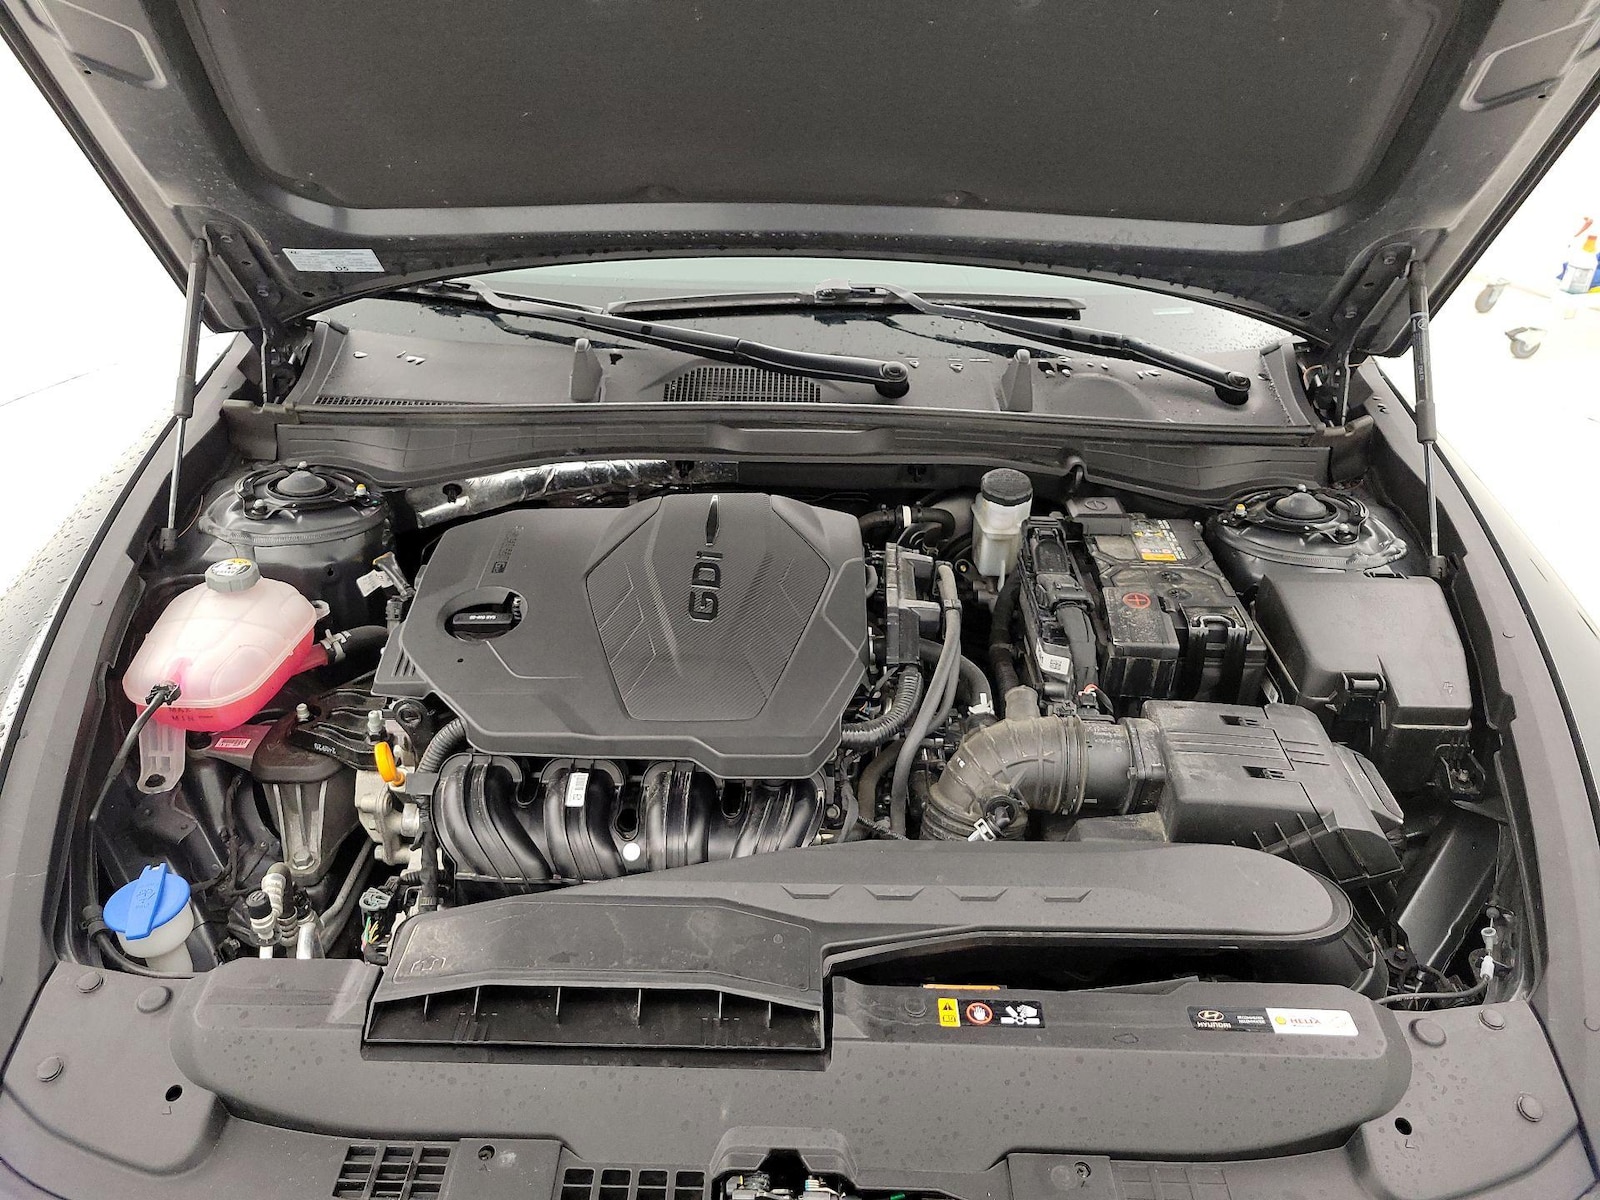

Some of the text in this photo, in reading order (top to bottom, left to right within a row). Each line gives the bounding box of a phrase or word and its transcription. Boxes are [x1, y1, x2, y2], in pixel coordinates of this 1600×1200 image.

[689, 550, 723, 622] GDi
[1197, 1021, 1232, 1029] HYUNDAI
[1290, 1017, 1322, 1025] HELIX
